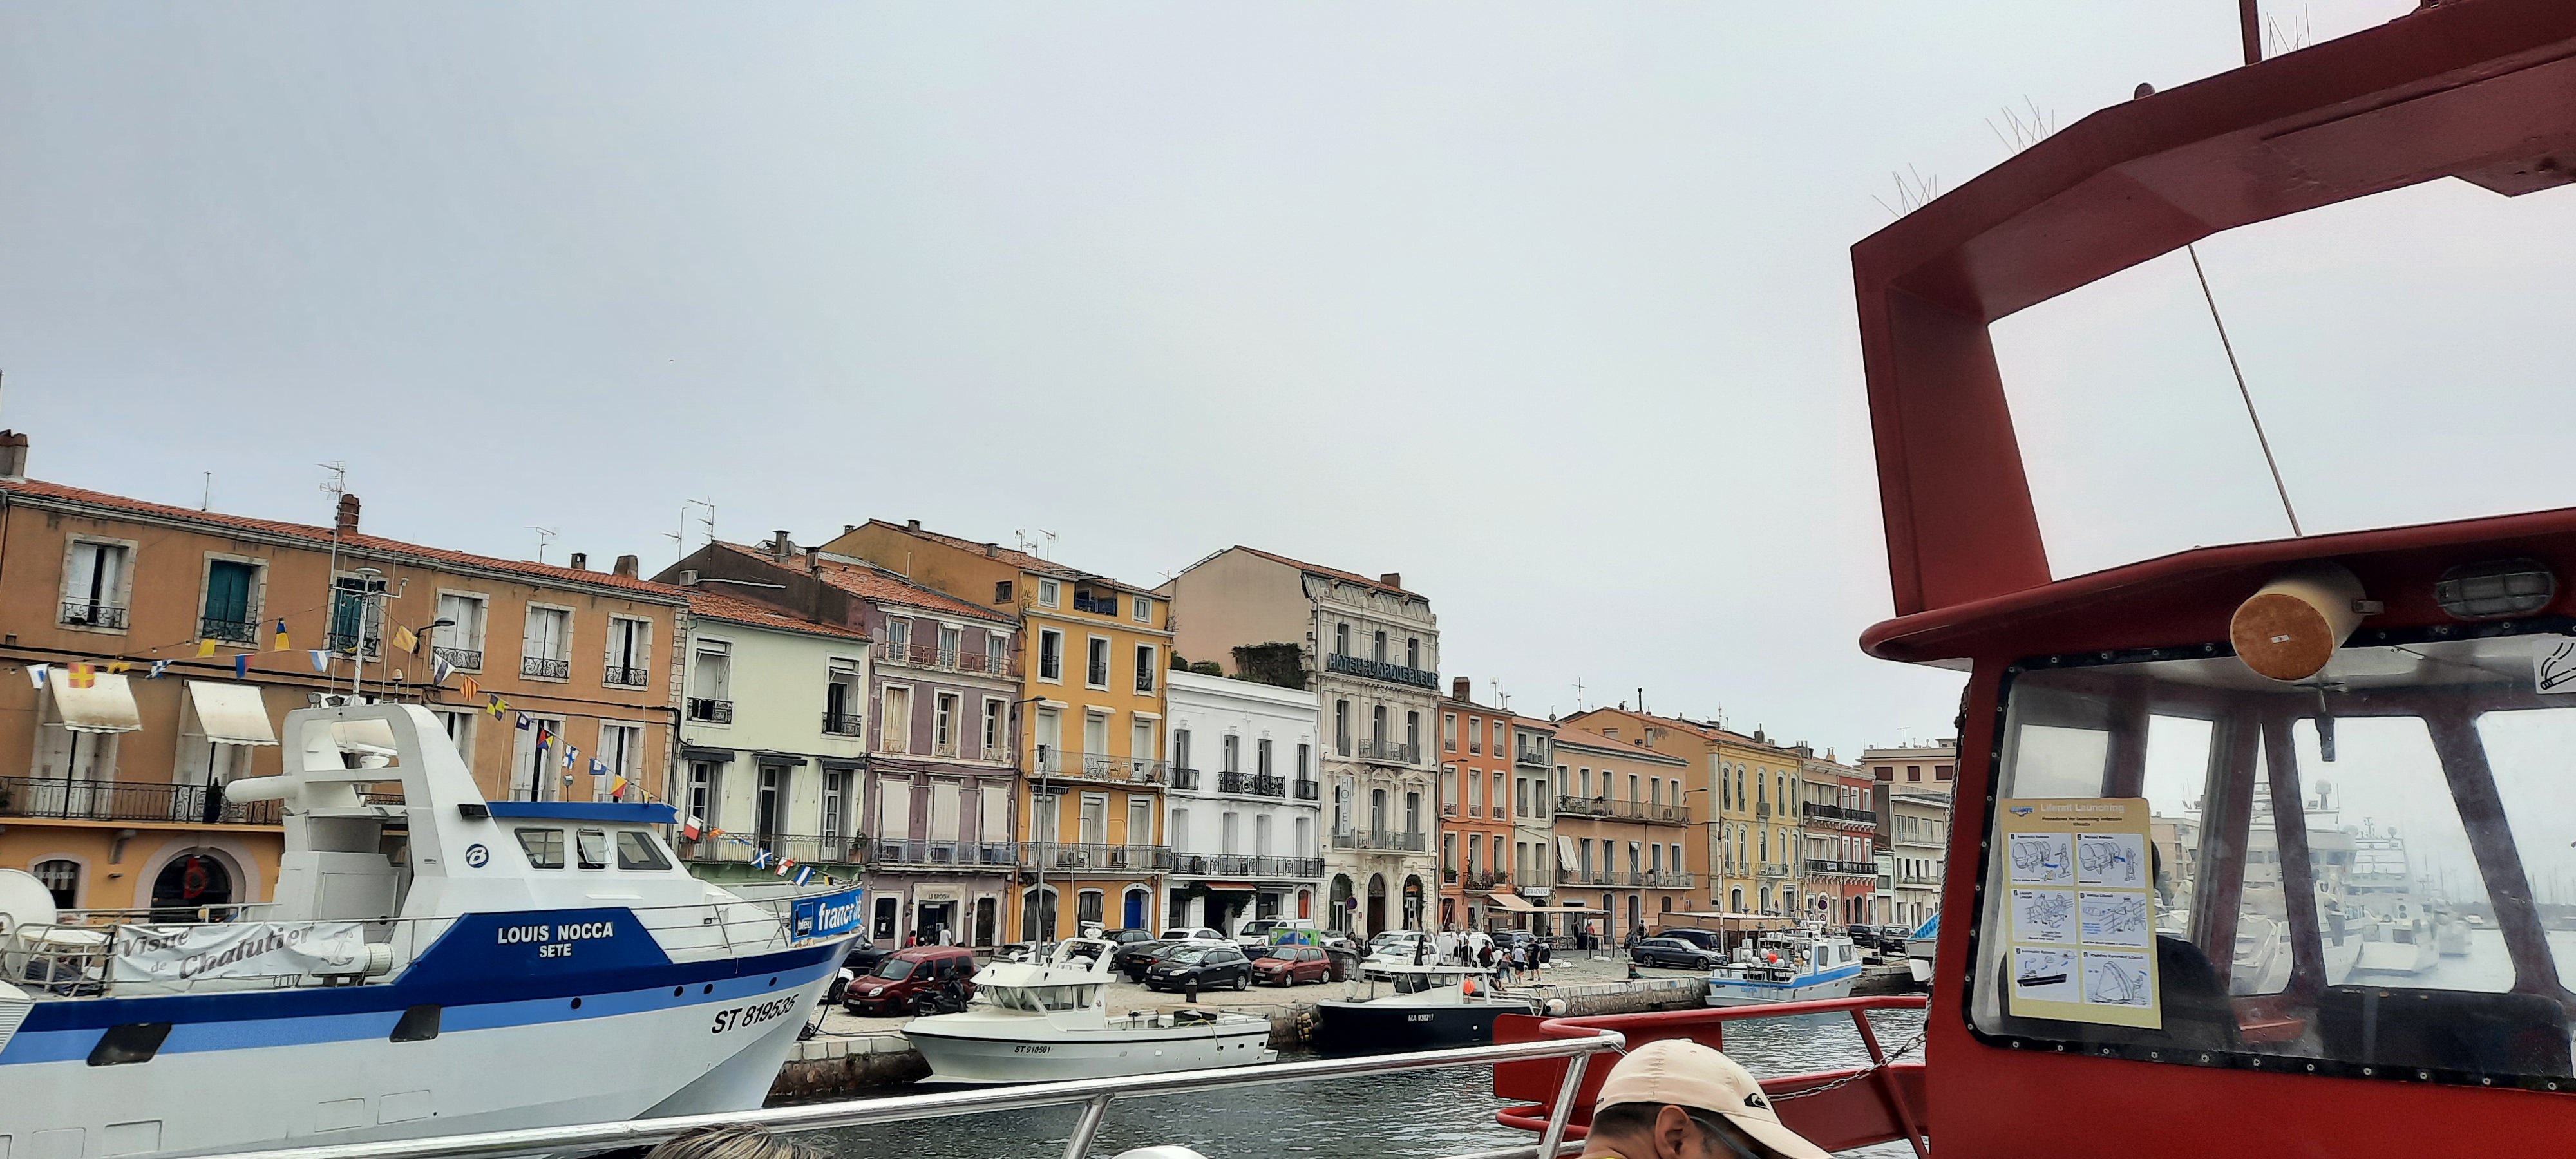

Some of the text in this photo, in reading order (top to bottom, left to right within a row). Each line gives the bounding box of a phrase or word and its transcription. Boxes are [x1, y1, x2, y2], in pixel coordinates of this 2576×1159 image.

[1341, 778, 1349, 833] HOTEL
[2075, 804, 2125, 814] Launching
[798, 919, 812, 930] bleu
[497, 921, 614, 945] LOUIS NOCCA
[179, 925, 315, 979] Chalutier
[539, 943, 572, 958] SETE
[151, 961, 167, 973] de
[712, 994, 800, 1034] ST 819535
[1014, 1045, 1026, 1053] ST
